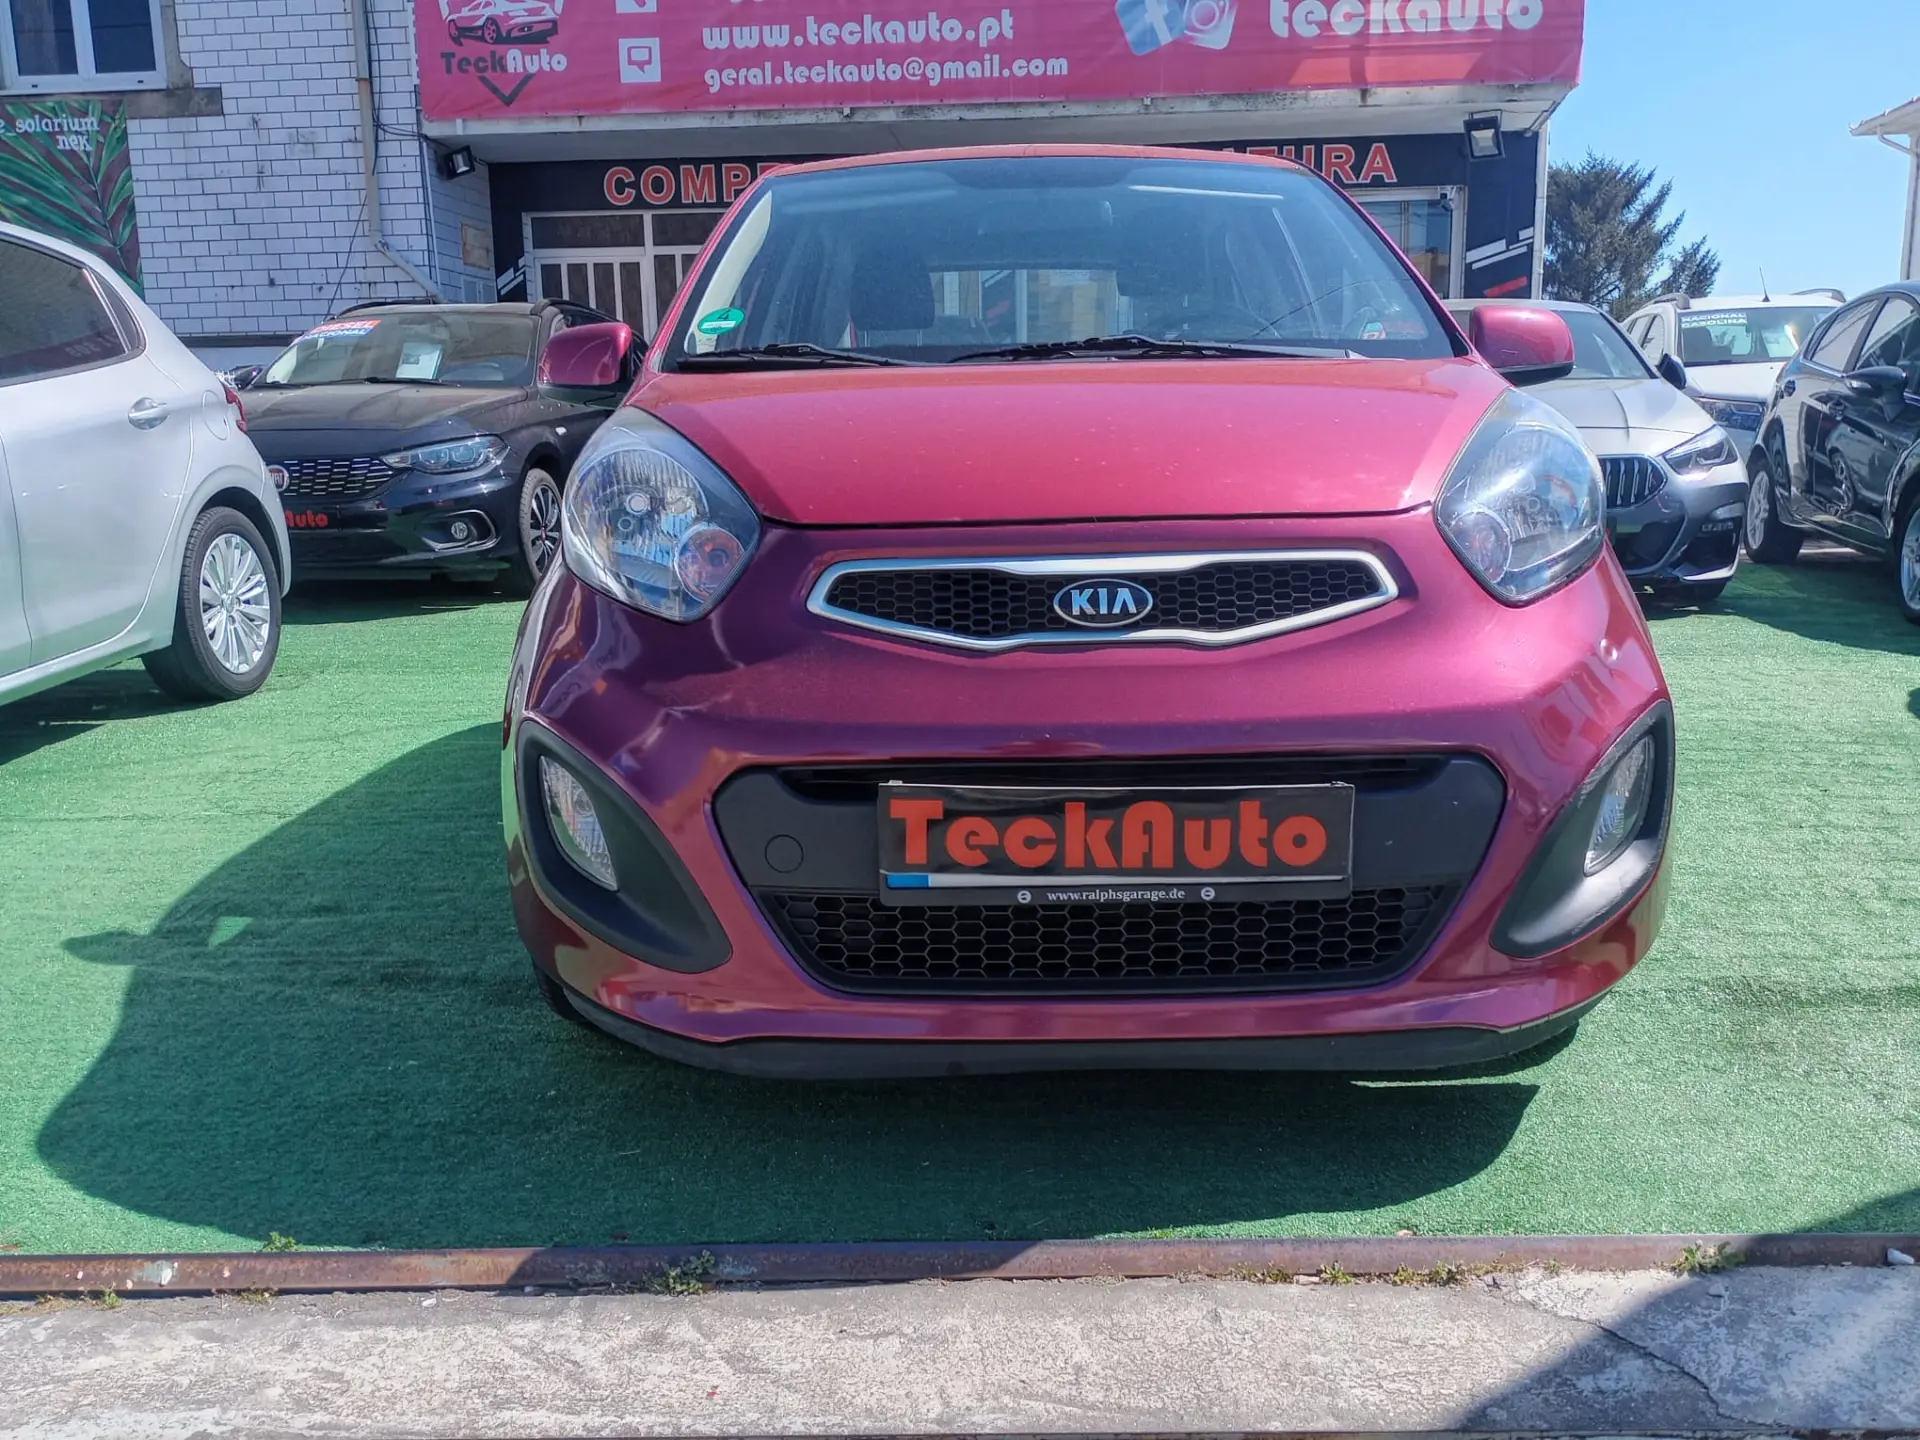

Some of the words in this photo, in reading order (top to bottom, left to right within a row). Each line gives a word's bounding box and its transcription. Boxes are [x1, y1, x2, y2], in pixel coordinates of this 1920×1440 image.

[702, 9, 1014, 50] www.teckauto.pt
[1269, 0, 1543, 38] teckauto
[440, 48, 567, 75] TeckAuto
[704, 54, 1068, 94] geral.teckauto@gmail.com
[15, 114, 99, 134] solarium
[604, 162, 779, 206] COMP
[1070, 588, 1137, 615] KIA
[889, 798, 1328, 870] TeckAuto
[1047, 888, 1186, 902] www.ralphsgarage.de
